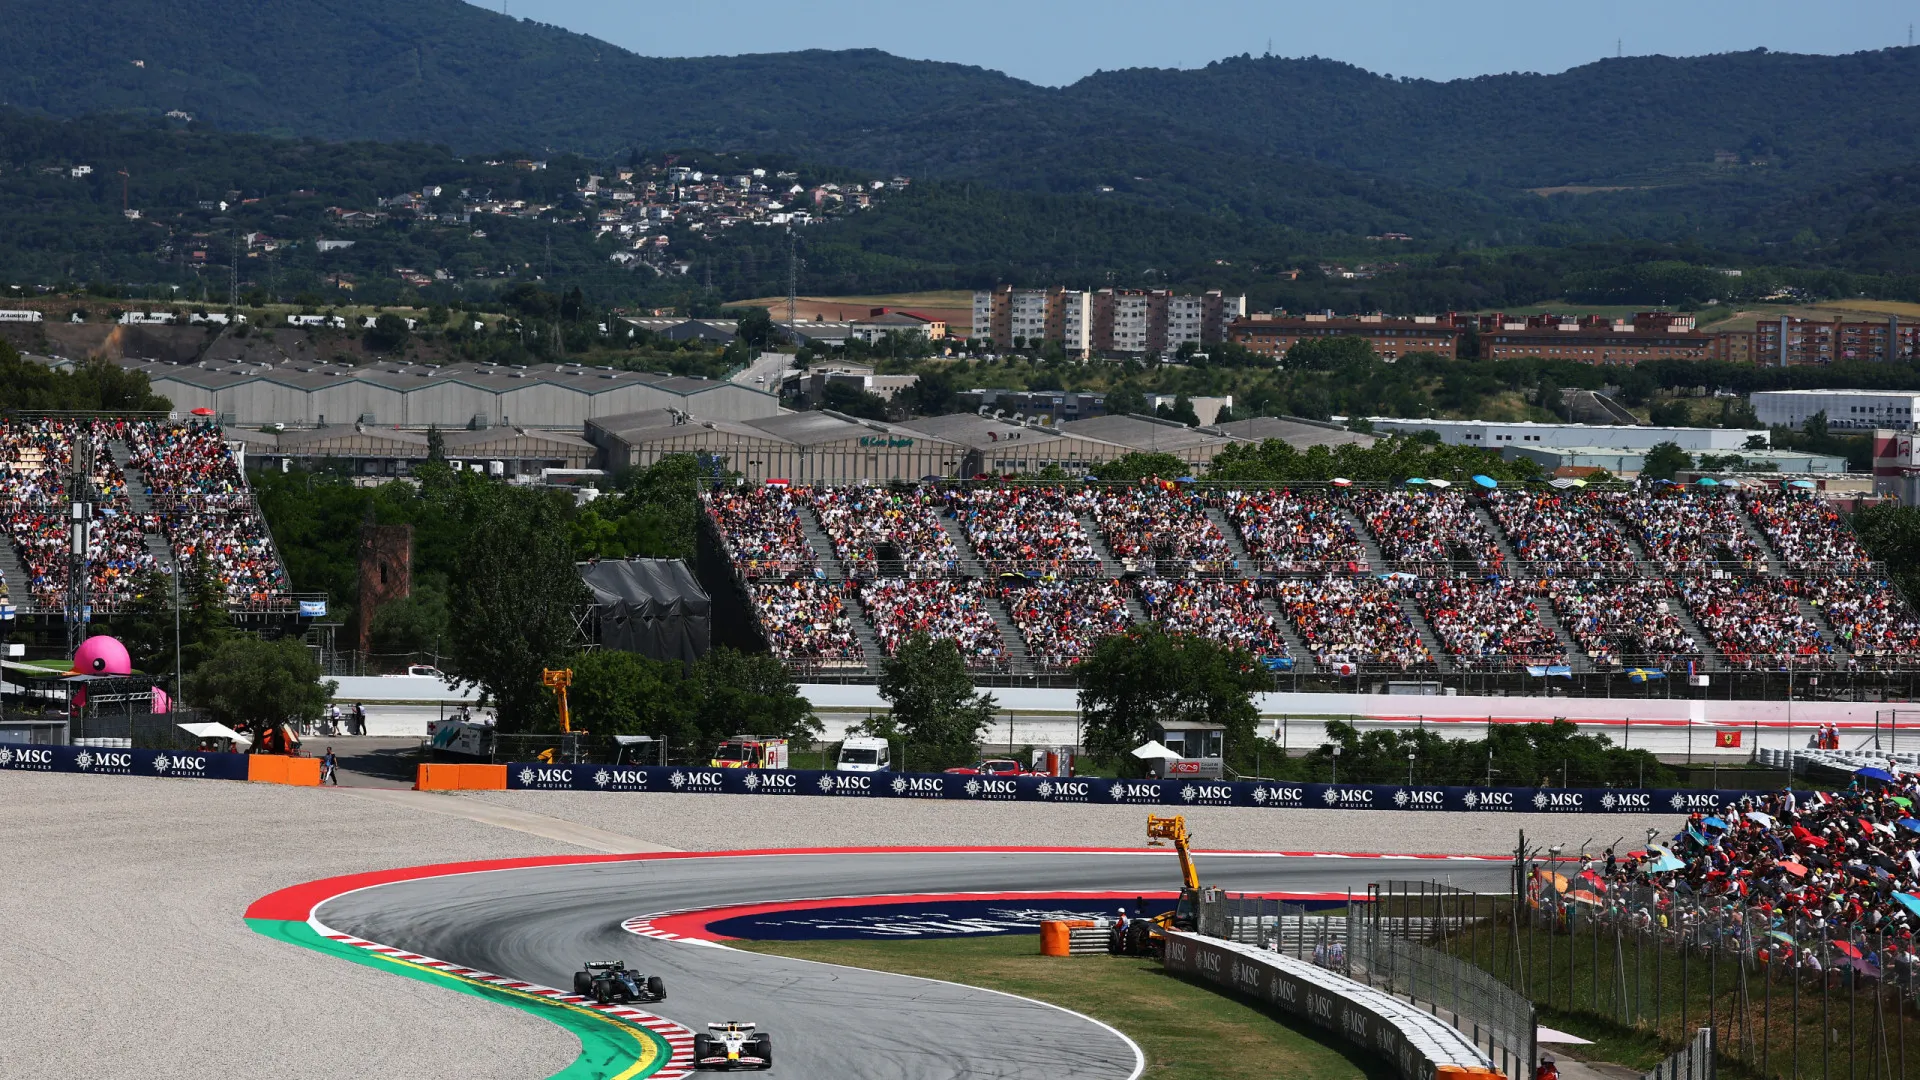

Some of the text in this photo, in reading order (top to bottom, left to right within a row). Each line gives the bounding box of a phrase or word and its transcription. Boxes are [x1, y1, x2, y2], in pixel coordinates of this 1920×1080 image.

[16, 749, 51, 763] MSC
[96, 753, 131, 766] MSC
[173, 756, 205, 769] MSC
[538, 769, 572, 782] MSC
[613, 771, 647, 783] MSC
[689, 772, 722, 785] MSC
[763, 774, 796, 786] MSC
[837, 776, 870, 789] MSC
[910, 778, 942, 791] MSC
[983, 780, 1016, 793] MSC
[1056, 782, 1088, 795] MSC
[1128, 784, 1160, 797] MSC
[1199, 786, 1231, 798] MSC
[1270, 788, 1302, 800] MSC
[1341, 790, 1372, 801] MSC
[1411, 791, 1443, 803] MSC
[1481, 792, 1512, 804] MSC
[1551, 794, 1582, 805] MSC
[1619, 794, 1649, 806] MSC
[1688, 795, 1718, 806] MSC
[1171, 942, 1187, 962] MSC
[1203, 951, 1221, 972] MSC
[1241, 963, 1260, 986] MSC
[1278, 978, 1297, 1003] MSC
[1315, 993, 1332, 1020] MSC
[1350, 1010, 1367, 1037] MSC
